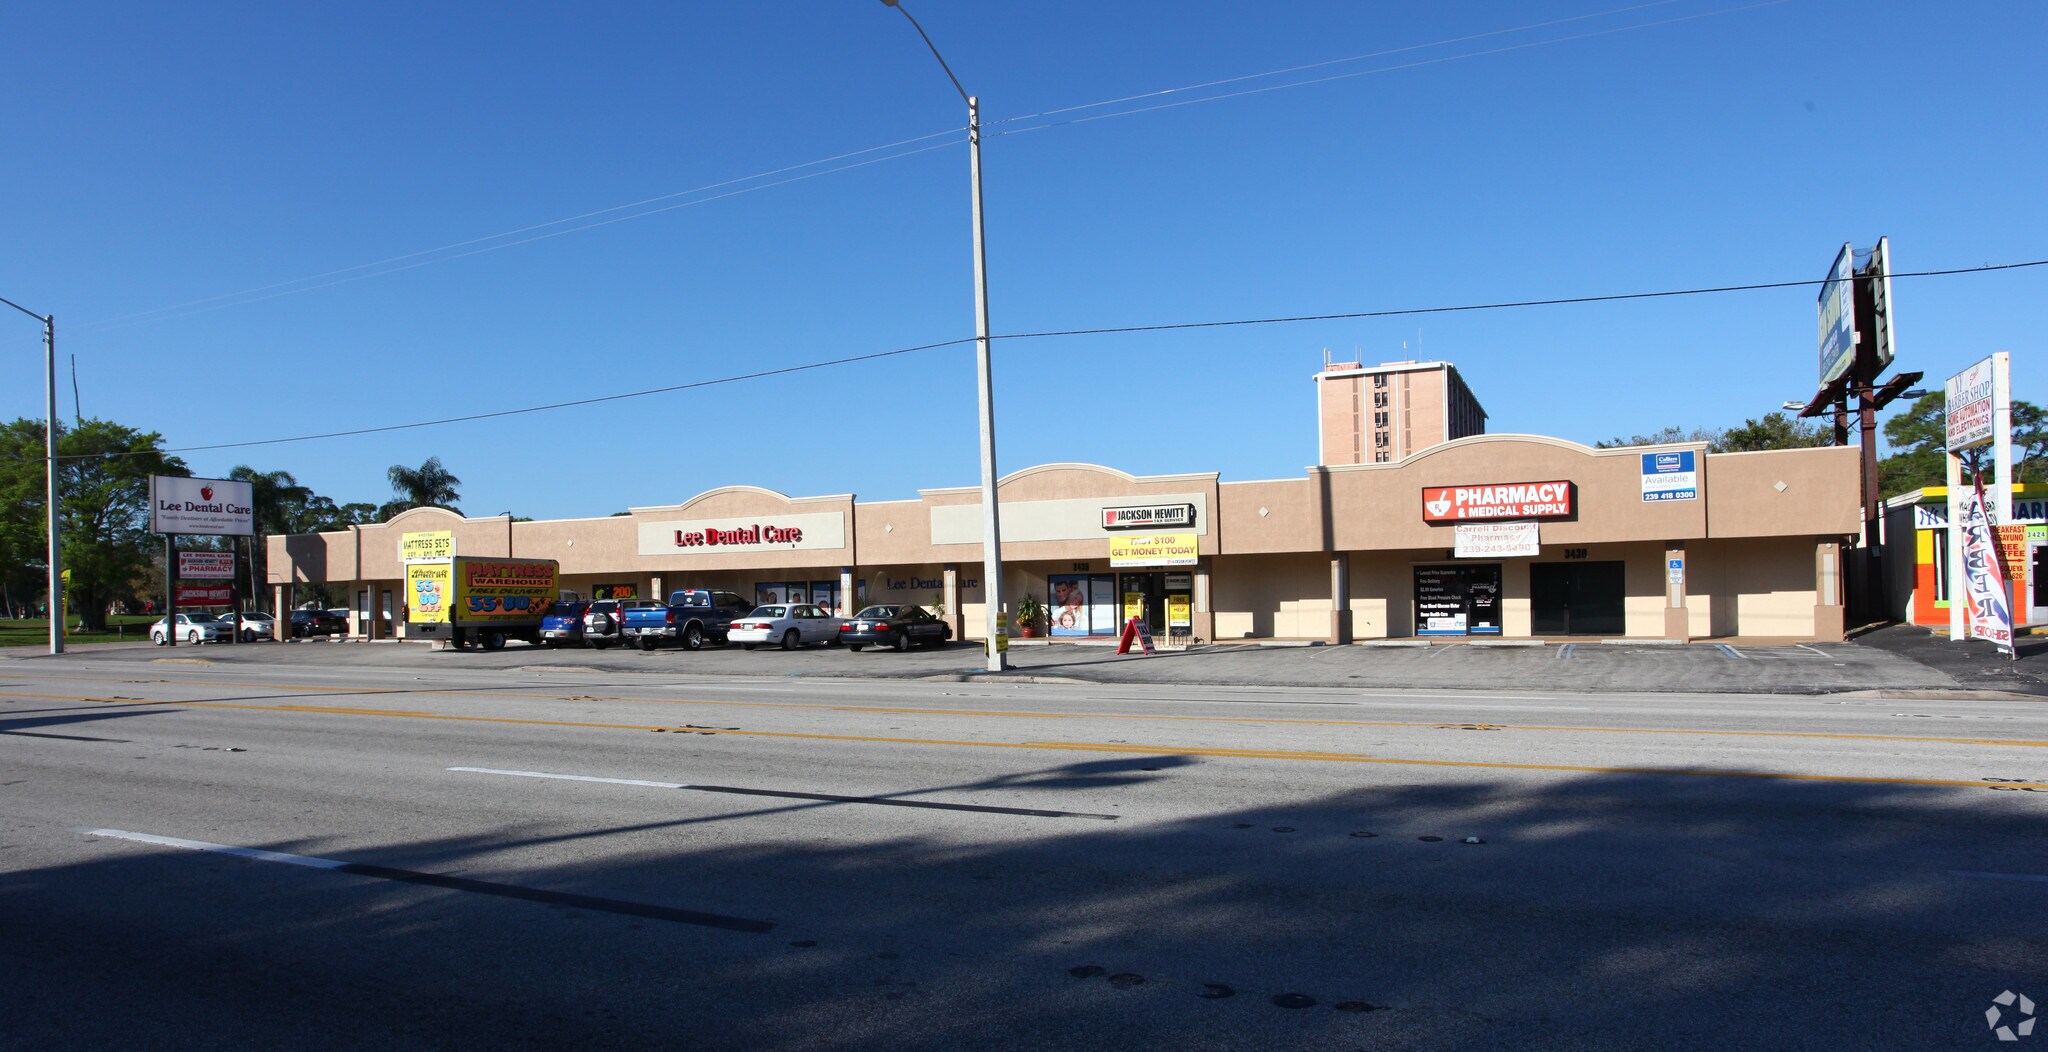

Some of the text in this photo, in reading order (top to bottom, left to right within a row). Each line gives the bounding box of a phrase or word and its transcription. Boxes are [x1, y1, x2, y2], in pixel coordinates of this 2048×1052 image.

[1947, 381, 1990, 413] BARBER SHOP
[1948, 398, 1990, 427] HOME AUTOMATION
[1956, 413, 1989, 434] ELECTRONICS
[1645, 475, 1688, 484] Available
[1455, 483, 1567, 506] PHARMACY
[160, 500, 251, 514] Lee Dental Care
[1458, 503, 1567, 518] & MEDICAL SUPPLY
[1118, 508, 1184, 521] JACKSON HEWITT
[1492, 523, 1537, 532] Discount
[674, 524, 802, 547] Lee Dental Care
[1154, 536, 1175, 545] $100
[1471, 534, 1521, 543] Pharmacy
[403, 538, 450, 549] MATTRESS SETS
[1112, 546, 1195, 557] GET MONEY TODAY
[466, 562, 554, 587] MATTRESS
[474, 578, 552, 586] WAREHOUSE
[886, 577, 978, 590] Lee Denta are
[183, 590, 208, 598] JACKSON
[527, 598, 545, 613] OFF
